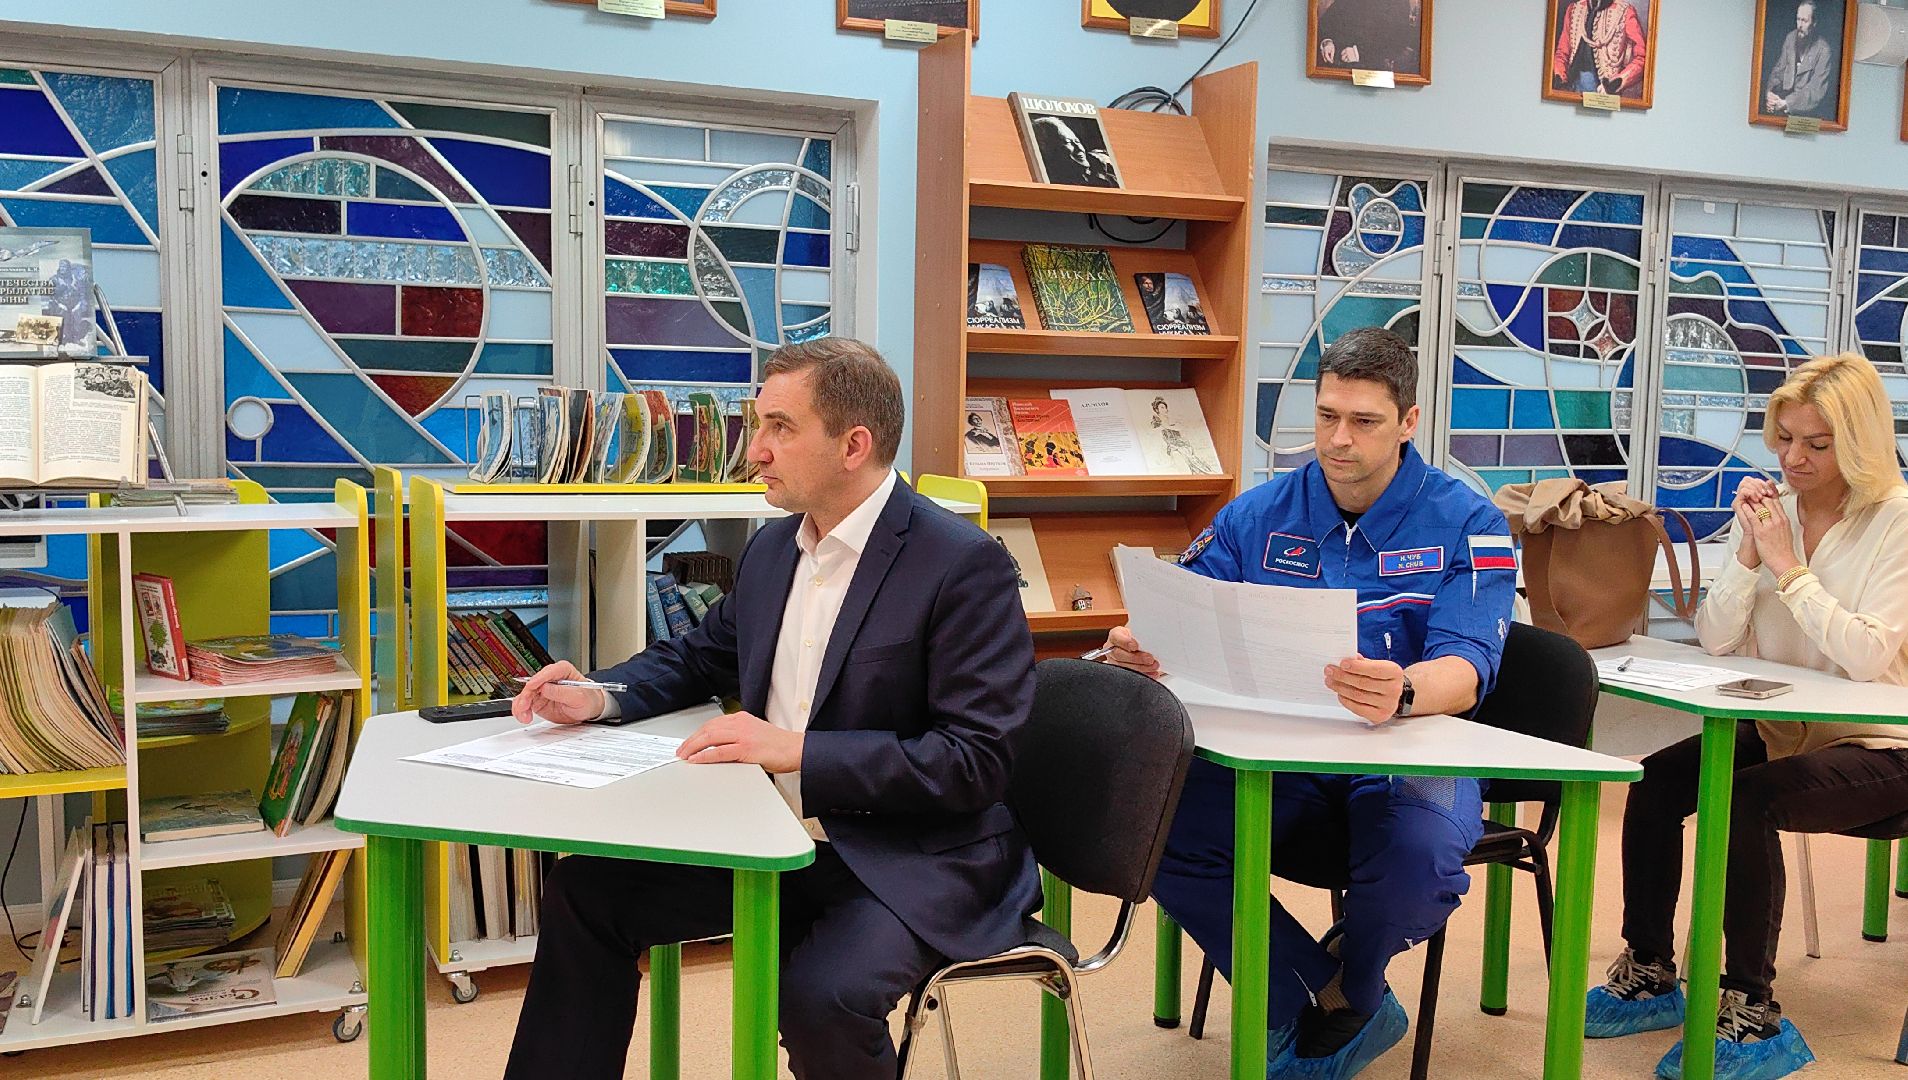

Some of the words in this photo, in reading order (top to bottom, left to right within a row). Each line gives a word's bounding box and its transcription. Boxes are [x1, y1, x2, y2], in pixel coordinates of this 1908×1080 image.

[1022, 97, 1096, 115] ШОЛОХОВ
[1156, 323, 1207, 331] СЮРРЕАЛИЗМ
[1407, 553, 1422, 561] ЧУБ
[1274, 557, 1310, 569] РОСКОСМОС
[1405, 560, 1424, 569] CHUB
